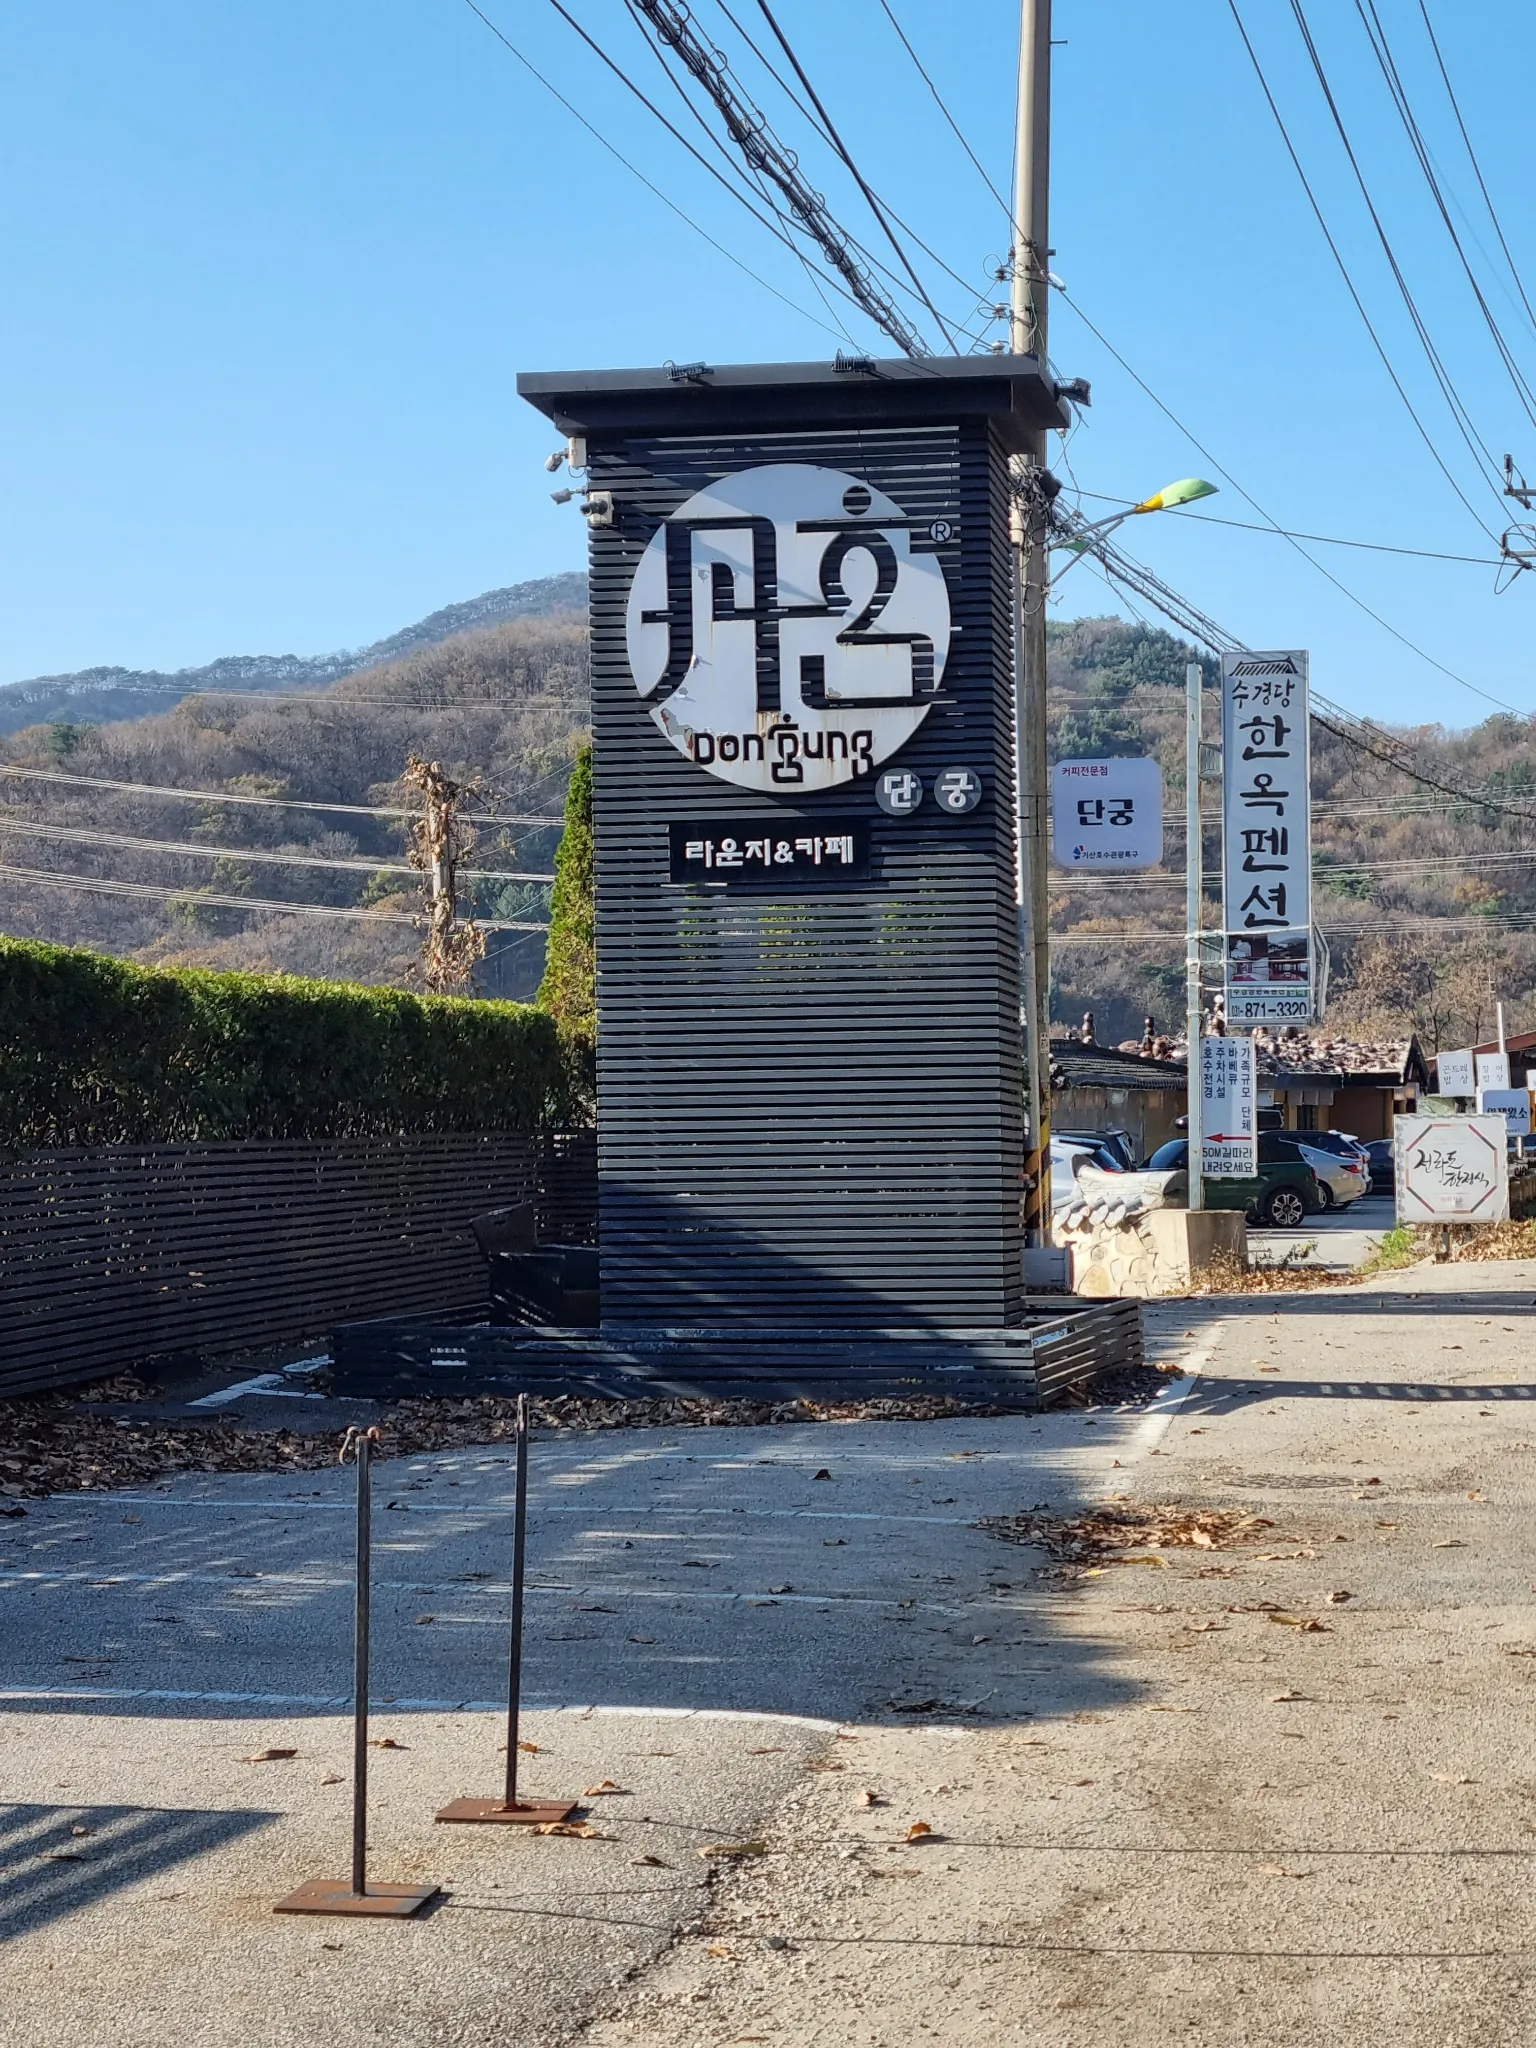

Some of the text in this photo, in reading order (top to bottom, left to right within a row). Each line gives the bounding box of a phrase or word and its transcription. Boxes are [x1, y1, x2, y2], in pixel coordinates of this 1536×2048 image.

[1231, 679, 1296, 709] 수경당
[1062, 766, 1108, 776] 커피전문점
[1077, 799, 1135, 826] 단궁
[1239, 714, 1291, 928] 한옥펜션
[685, 836, 854, 868] 라운지&카페
[1082, 851, 1139, 860] 기산호수관광특구
[1203, 1046, 1213, 1099] 호수전경
[1215, 1047, 1226, 1099] 주차시설
[1228, 1046, 1239, 1086] 바베큐
[1442, 1063, 1468, 1075] 곤드레
[1240, 1046, 1251, 1132] 가족규모 단체
[1202, 1161, 1254, 1173] 내려오세요
[1413, 1149, 1464, 1182] 전라도
[1443, 1171, 1490, 1189] 한정식
